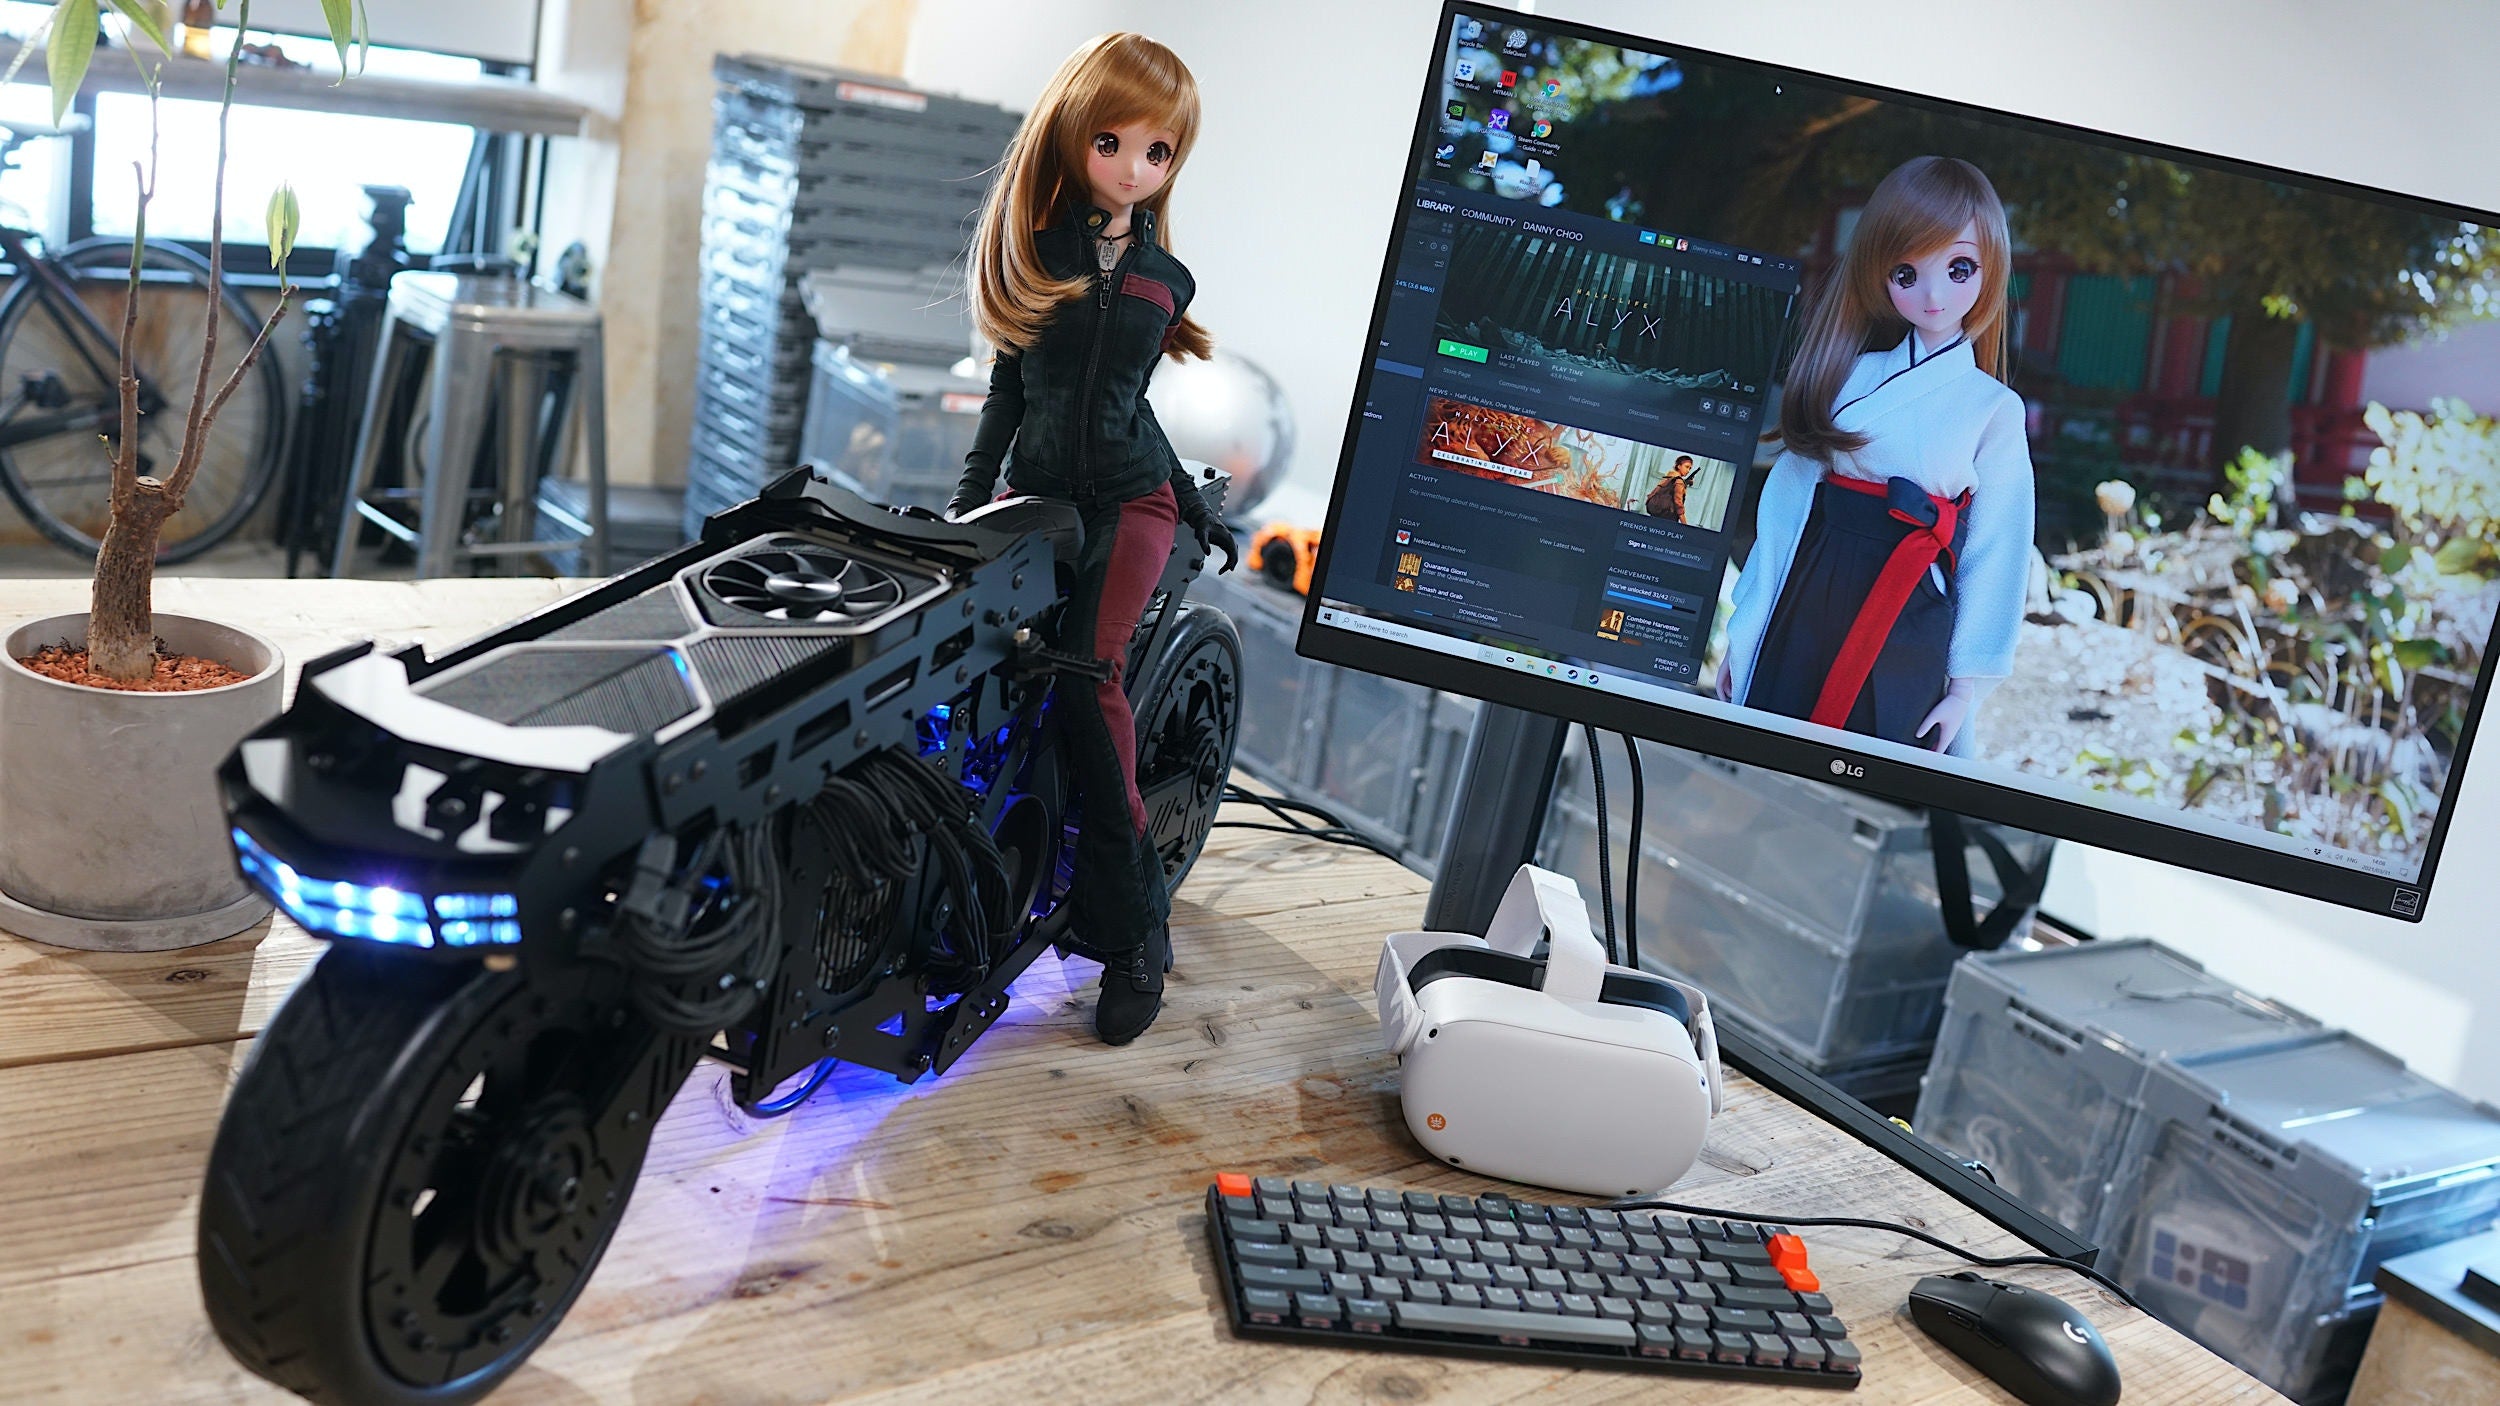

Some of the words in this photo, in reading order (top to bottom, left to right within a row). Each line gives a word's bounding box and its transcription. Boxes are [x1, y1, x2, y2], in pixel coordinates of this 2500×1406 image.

[1503, 48, 1527, 59] SideQuest
[1493, 89, 1513, 98] HITMAN
[1518, 136, 1533, 144] Steam
[1533, 139, 1561, 151] Community
[1436, 161, 1451, 169] Steam
[1416, 198, 1456, 214] LIBRARY
[1461, 207, 1517, 228] COMMUNITY
[1522, 221, 1555, 236] DANNY
[1555, 228, 1584, 242] CHOO
[1555, 297, 1661, 339] ALYX
[1460, 348, 1478, 358] PLAY
[1499, 353, 1515, 362] LAST
[1516, 357, 1540, 367] PLAYED
[1457, 370, 1472, 380] Page
[1551, 365, 1568, 374] PLAY
[1568, 368, 1584, 377] TIME
[1498, 379, 1529, 393] Community
[1562, 375, 1578, 383] hours
[1428, 386, 1448, 396] NEWS
[1454, 392, 1480, 403] Half-Life
[1494, 401, 1507, 409] One
[1507, 404, 1522, 412] Year
[1521, 407, 1537, 416] Later
[1628, 408, 1660, 421] Discussions
[1431, 421, 1544, 466] ALYX
[1437, 452, 1488, 468] CELEBRATING
[1492, 464, 1506, 472] ONE
[1509, 468, 1528, 477] YEAR
[1409, 472, 1439, 484] ACTIVITY
[1408, 488, 1420, 496] Say
[1420, 490, 1451, 503] something
[1451, 497, 1468, 506] about
[1468, 501, 1480, 509] this
[1479, 505, 1496, 514] game
[1504, 510, 1517, 519] your
[1399, 518, 1421, 528] TODAY
[1619, 520, 1648, 532] FRIENDS
[1649, 527, 1666, 536] WHO
[1667, 531, 1684, 540] PLAY
[1441, 543, 1467, 554] achieved
[1539, 538, 1553, 546] View
[1553, 541, 1570, 550] Latest
[1570, 545, 1586, 554] News
[1628, 539, 1641, 549] Sign
[1664, 548, 1681, 557] friend
[1423, 561, 1450, 573] Quaranta
[1422, 568, 1437, 576] Enter
[1446, 573, 1476, 586] Quarantine
[1608, 566, 1660, 583] ACHIEVEMENTS
[1418, 584, 1438, 594] Smash
[1437, 589, 1449, 597] and
[1449, 591, 1464, 600] Grab
[1609, 582, 1627, 591] You've
[1627, 585, 1652, 597] unlocked
[1458, 608, 1499, 623] DOWNLOADING
[1353, 620, 1367, 630] Type
[1367, 624, 1381, 633] here
[1389, 629, 1409, 639] search
[1626, 615, 1652, 626] Combine
[1652, 621, 1681, 632] Harvester
[1623, 628, 1634, 636] loot
[1645, 626, 1665, 637] gravity
[1664, 631, 1685, 641] gloves
[1655, 657, 1679, 668] FRIENDS
[1658, 664, 1673, 672] CHAT
[1846, 764, 1865, 778] LG
